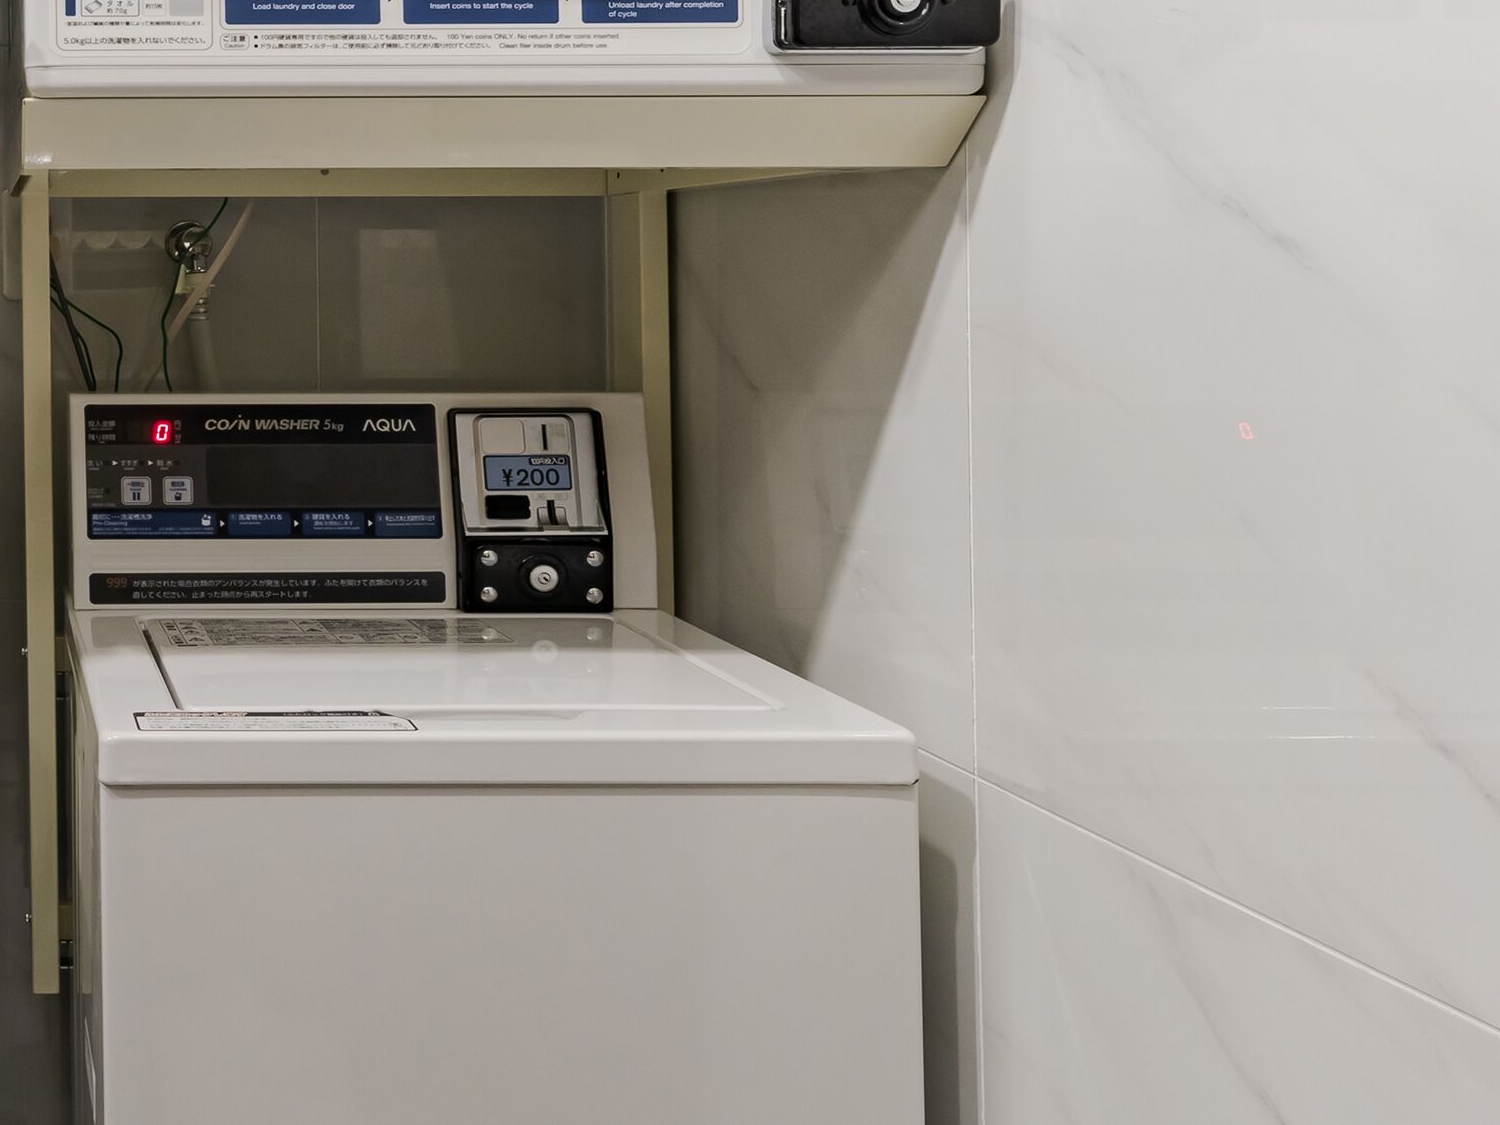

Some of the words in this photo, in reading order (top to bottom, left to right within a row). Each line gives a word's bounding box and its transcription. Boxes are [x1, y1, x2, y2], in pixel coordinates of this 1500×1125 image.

[273, 3, 299, 11] laundry
[514, 3, 533, 11] cycle
[637, 1, 663, 10] laundry
[683, 1, 724, 10] completion
[618, 10, 637, 18] cycle
[254, 419, 320, 431] WASHER
[324, 419, 344, 432] 5kg
[363, 419, 416, 432] AQUA
[156, 423, 169, 441] 0
[502, 468, 559, 486] ¥200
[106, 577, 127, 587] 999
